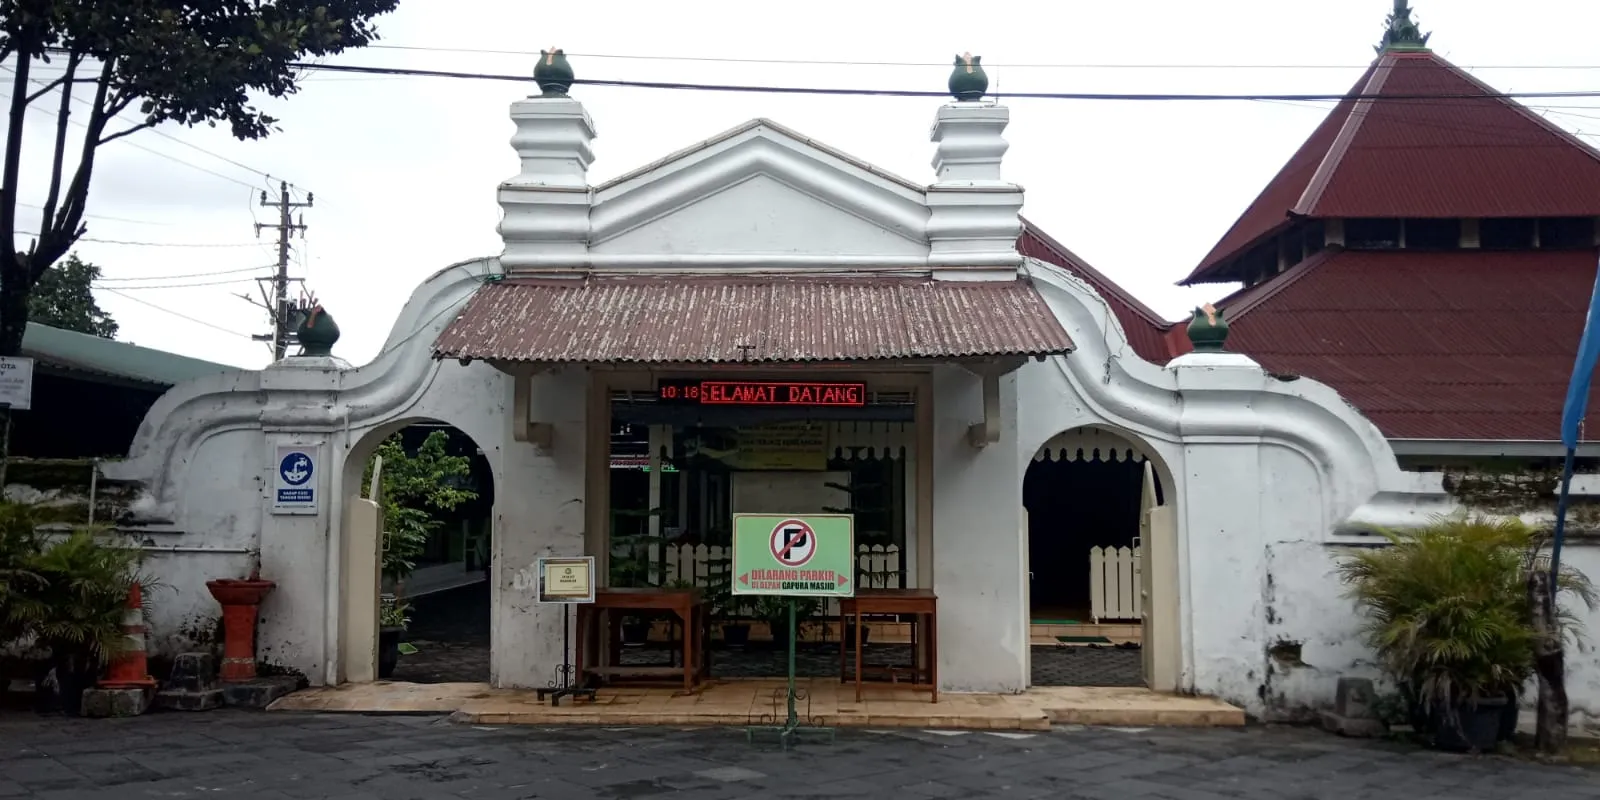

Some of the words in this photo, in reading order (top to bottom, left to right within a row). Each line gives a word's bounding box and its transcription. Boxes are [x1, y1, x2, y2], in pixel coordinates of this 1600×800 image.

[660, 385, 699, 398] 10:18
[701, 384, 777, 402] SELAMAT
[789, 386, 857, 403] DATANG
[752, 569, 798, 580] DILARANG
[800, 570, 835, 581] PARKIR
[782, 581, 809, 590] GAPURA
[810, 582, 835, 590] MASJID
